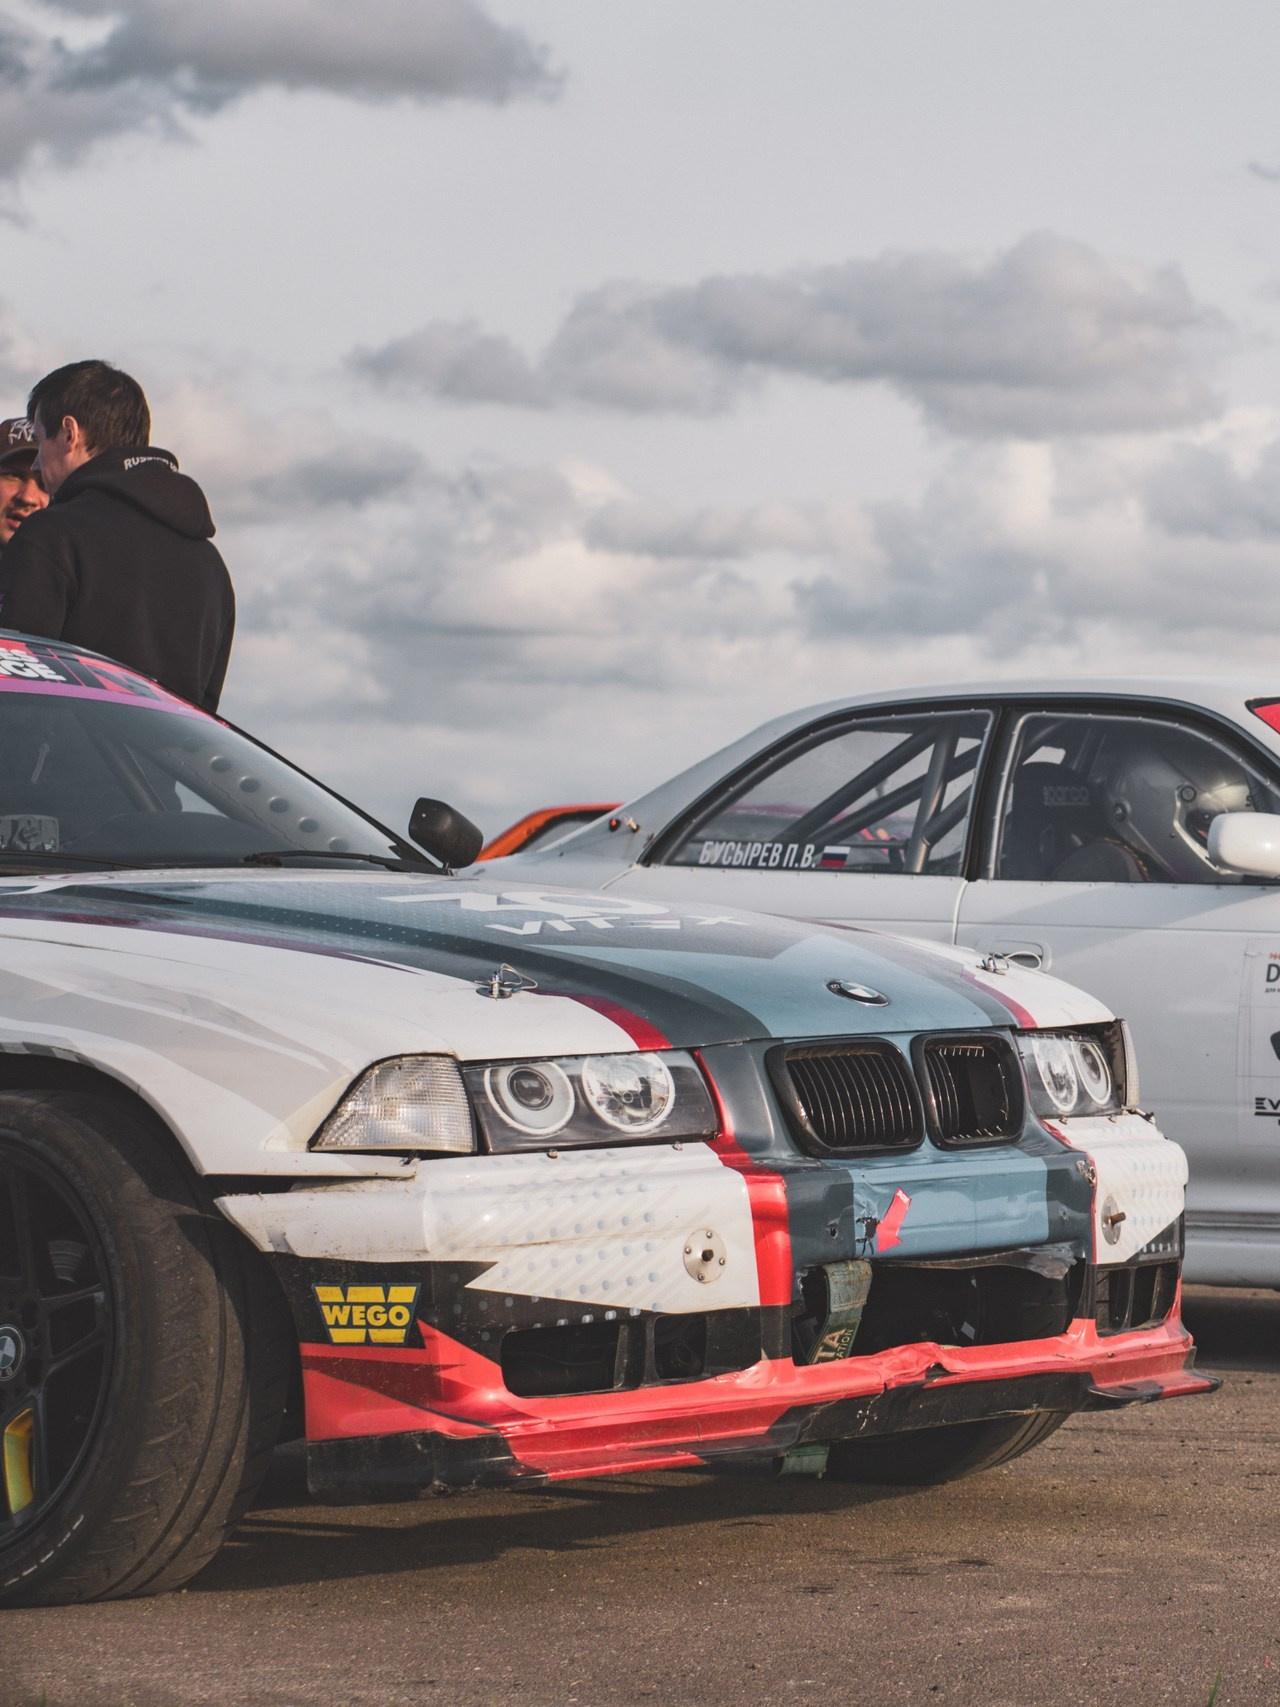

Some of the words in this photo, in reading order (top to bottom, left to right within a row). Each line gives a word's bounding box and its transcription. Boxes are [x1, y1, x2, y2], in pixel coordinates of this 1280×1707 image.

[699, 841, 783, 867] БУСЫРЕВ
[782, 843, 816, 868] П.В.
[321, 1305, 410, 1326] WEGO
